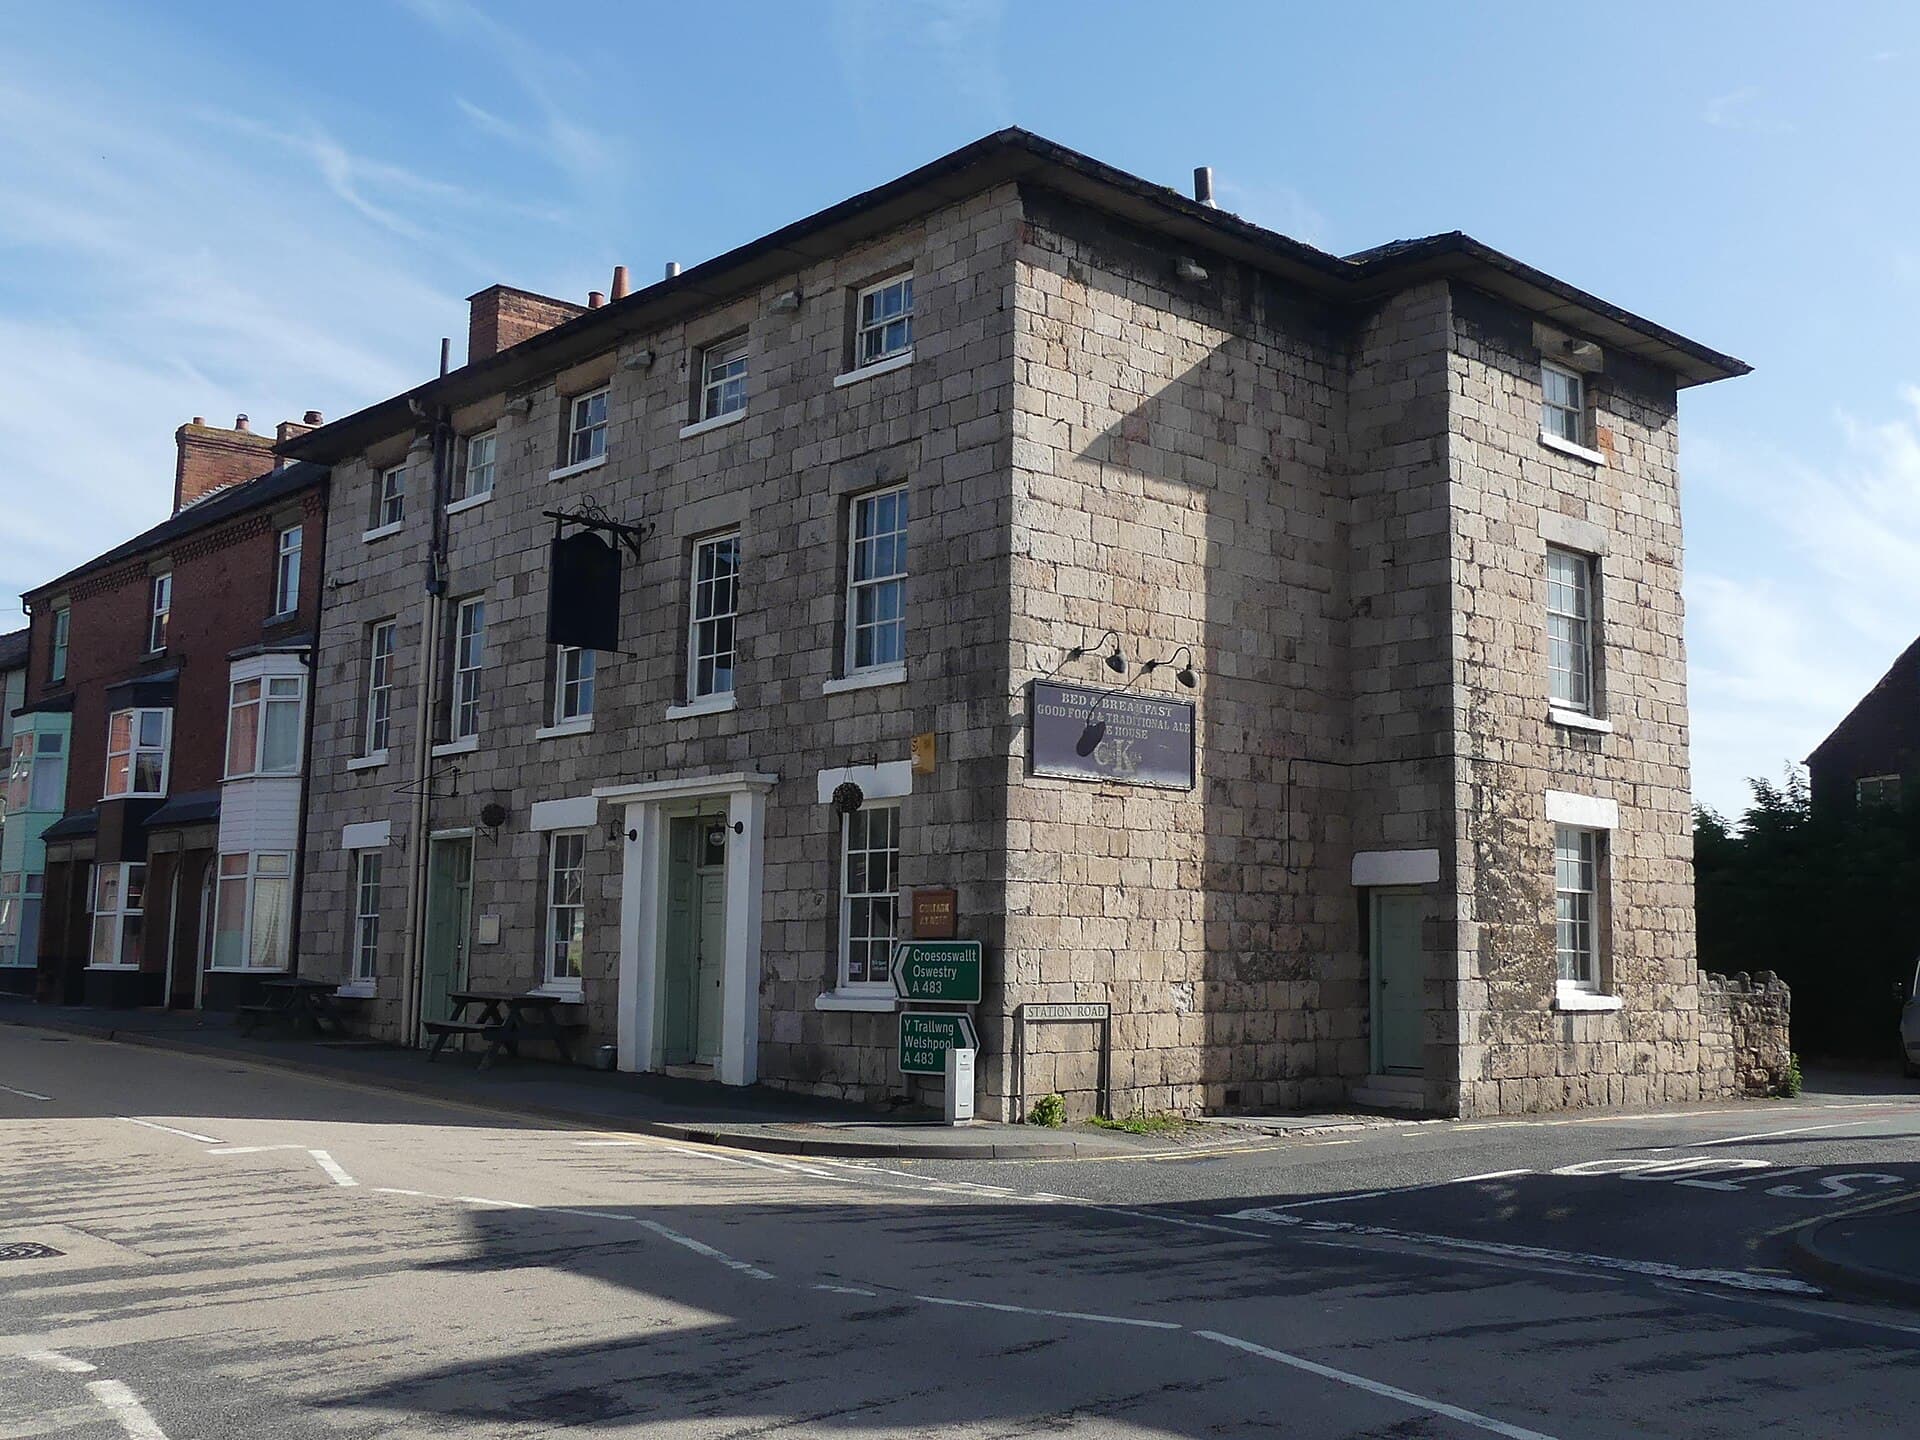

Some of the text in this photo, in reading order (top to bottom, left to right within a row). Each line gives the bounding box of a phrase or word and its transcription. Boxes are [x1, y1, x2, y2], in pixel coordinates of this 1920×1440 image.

[1061, 693, 1087, 706] BED
[1089, 697, 1099, 707] &
[1037, 704, 1066, 717] GOOD
[1068, 708, 1095, 721] FOOD
[1096, 712, 1105, 723] &
[1106, 712, 1170, 731] TRADITIONAL
[1115, 726, 1148, 740] HOUSE
[913, 948, 977, 962] Croesoswallt
[913, 965, 957, 981] Oswestry
[912, 981, 942, 994] A 483
[1028, 1006, 1105, 1017] STATION ROAD
[904, 1019, 954, 1036] Y Trallwng
[904, 1035, 954, 1052] Welshpool
[904, 1051, 934, 1065] A 483
